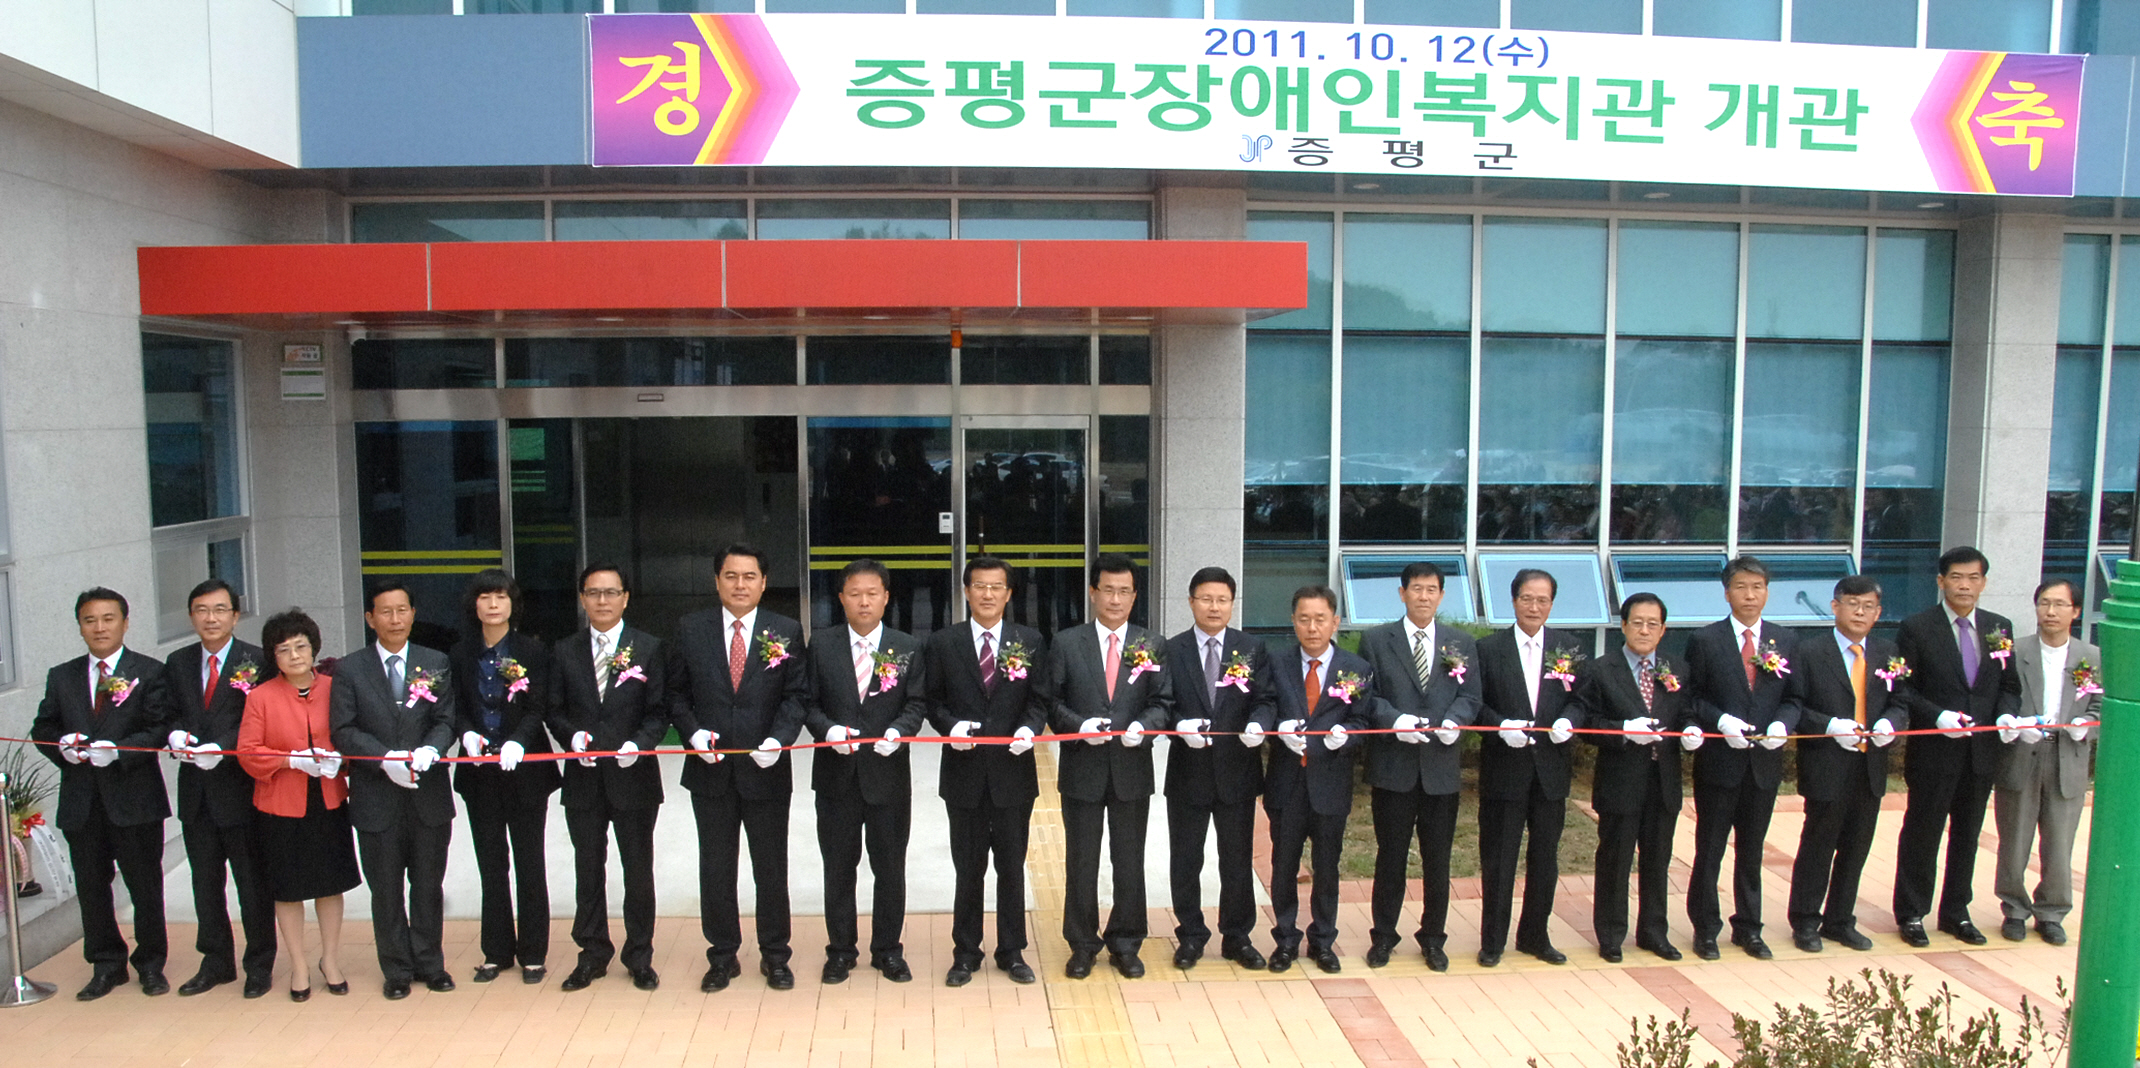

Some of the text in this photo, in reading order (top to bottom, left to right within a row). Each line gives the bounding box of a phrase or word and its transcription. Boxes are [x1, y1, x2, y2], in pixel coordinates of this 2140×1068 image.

[616, 41, 701, 136] 경
[1204, 27, 1550, 69] 2011. 10. 12(수)
[846, 59, 1871, 153] 증평군장애인복지관 개관
[1975, 80, 2065, 171] 축
